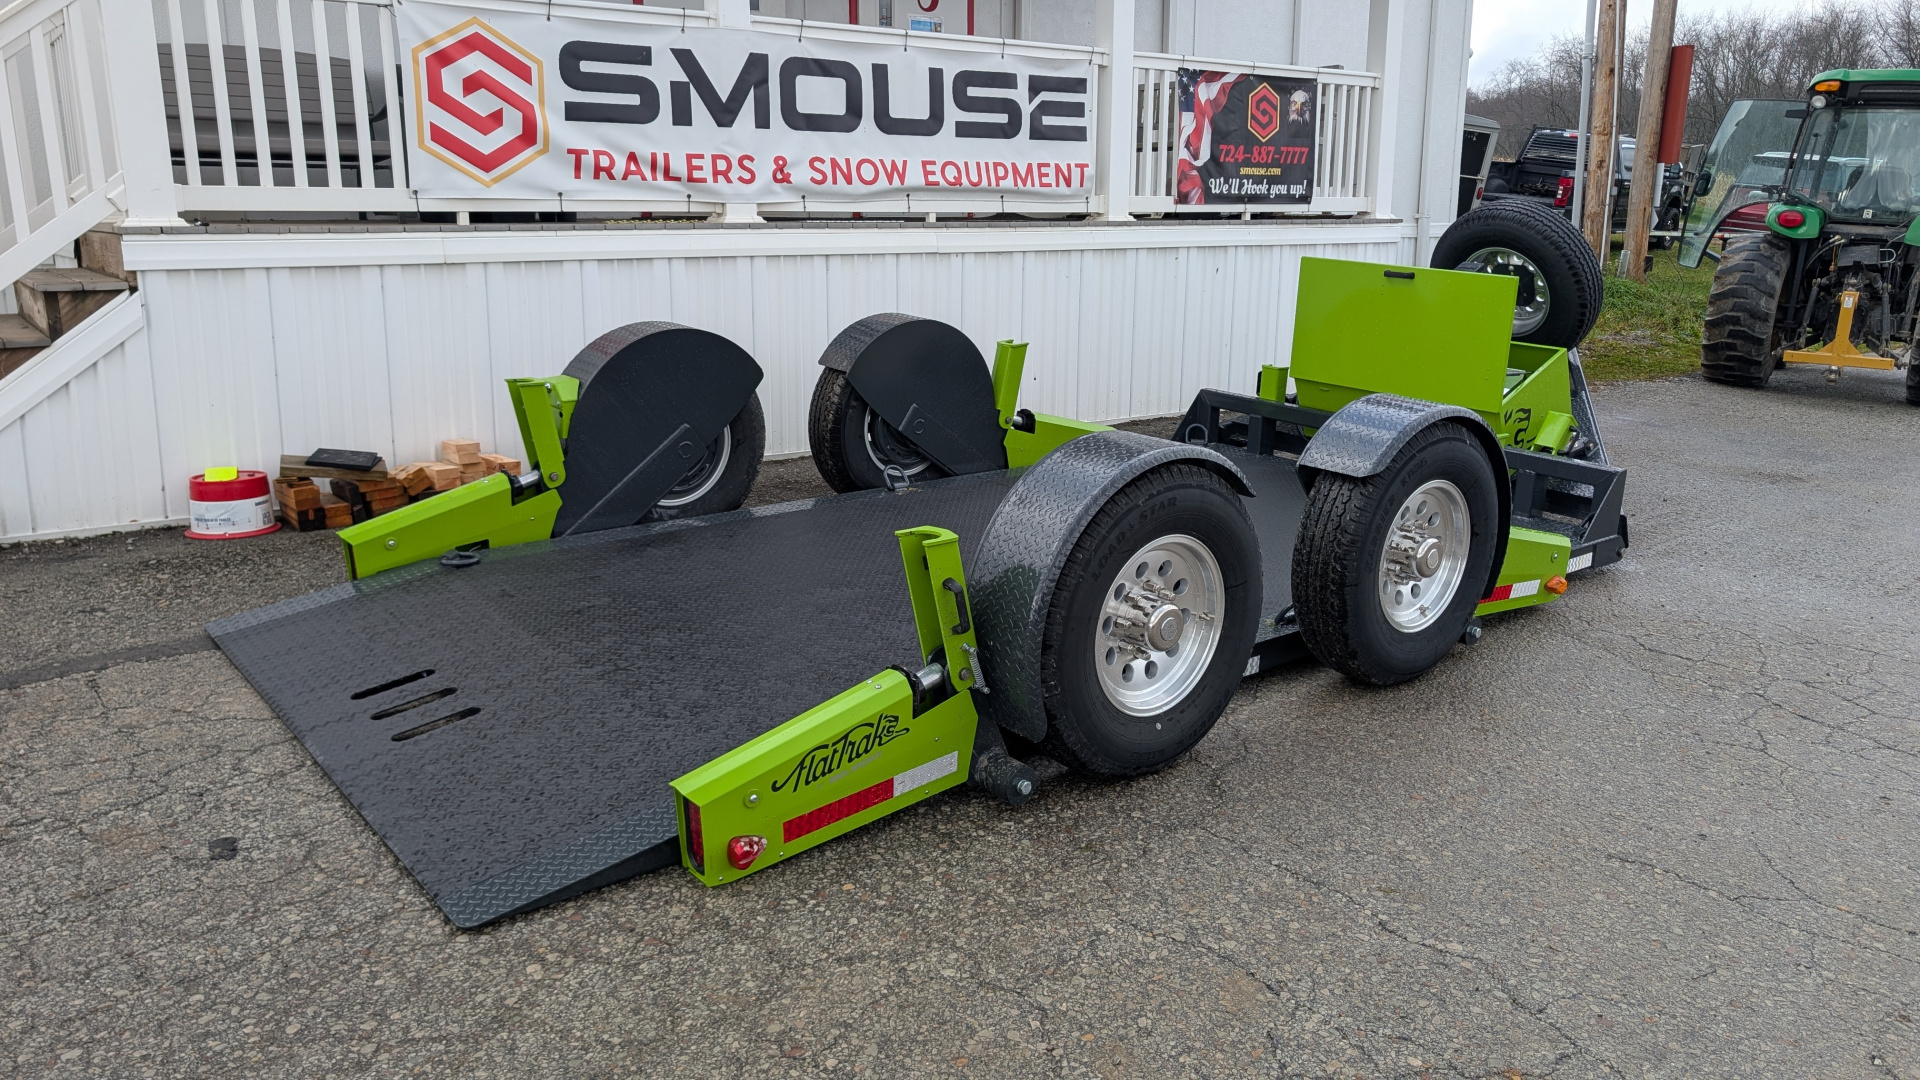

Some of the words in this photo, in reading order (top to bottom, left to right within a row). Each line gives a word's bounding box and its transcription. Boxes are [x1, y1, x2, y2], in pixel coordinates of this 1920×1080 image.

[558, 39, 1088, 142] SMOUSE
[566, 148, 757, 185] TRAILERS
[771, 155, 793, 185] &
[808, 156, 909, 187] SNOW
[920, 159, 1090, 189] EQUIPMENT
[1219, 144, 1309, 165] 724-887-7777
[1239, 166, 1281, 176] smouse.com
[1208, 176, 1240, 195] We'll
[1240, 178, 1270, 195] Hook
[1269, 183, 1288, 199] you
[1289, 179, 1308, 199] up!
[1090, 530, 1127, 583] LOAD
[1137, 496, 1179, 524] STAR
